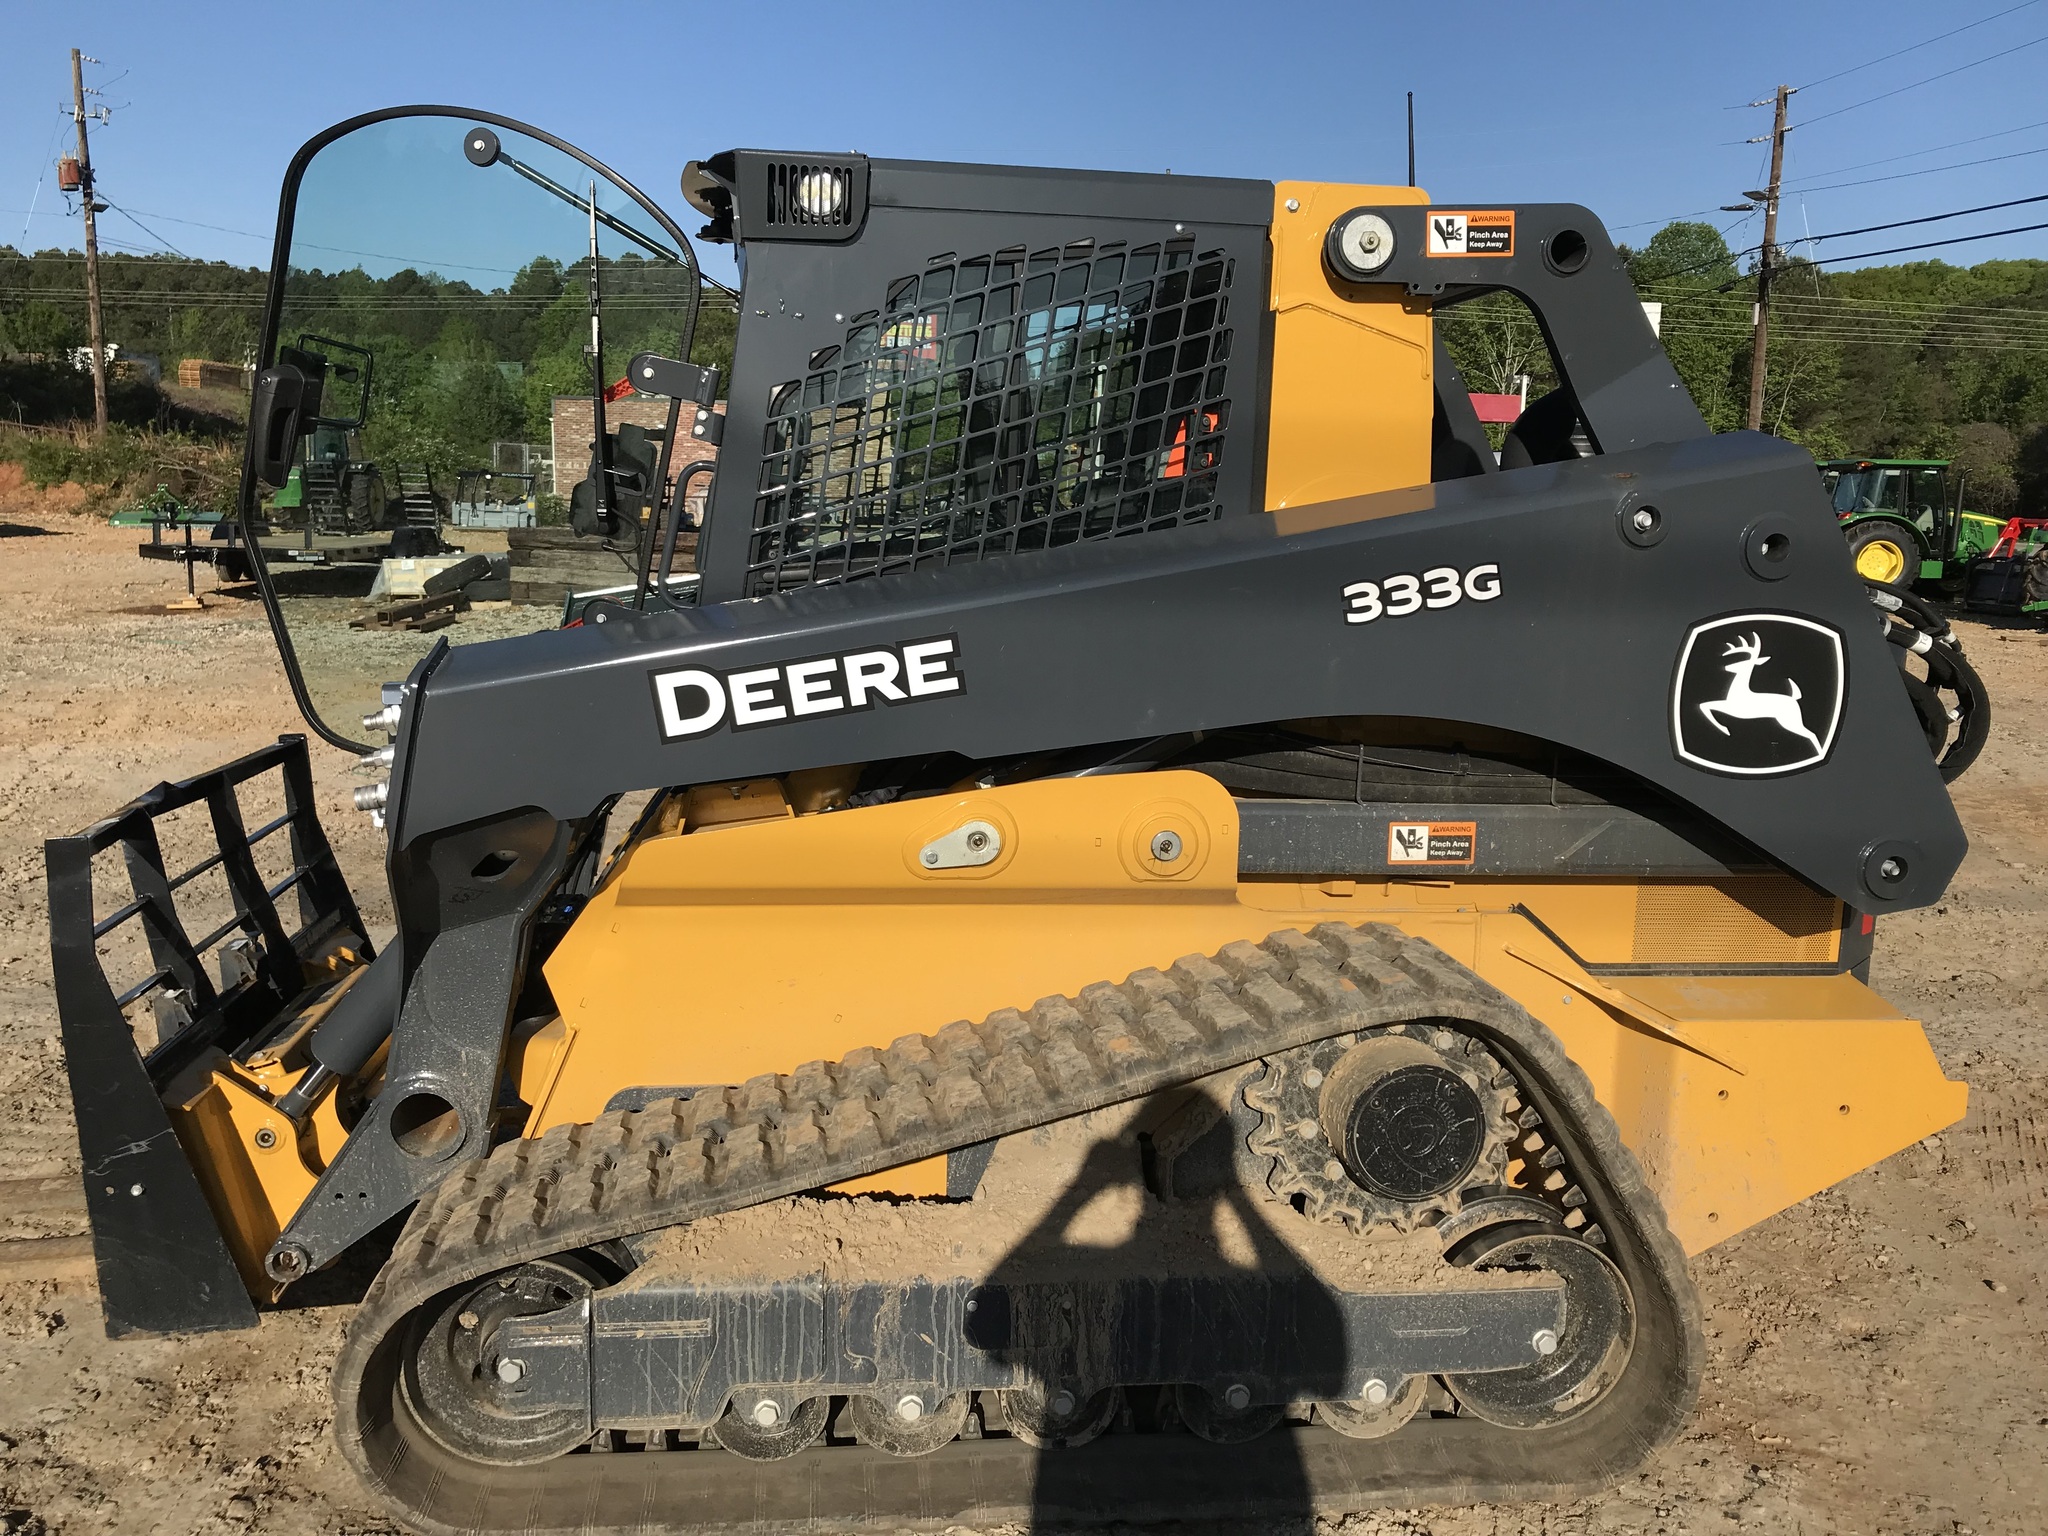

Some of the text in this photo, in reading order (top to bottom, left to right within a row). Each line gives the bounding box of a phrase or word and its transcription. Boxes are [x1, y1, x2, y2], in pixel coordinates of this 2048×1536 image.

[1469, 231, 1509, 239] Pinch Area
[1343, 564, 1502, 623] 333G
[654, 639, 960, 738] DEERE
